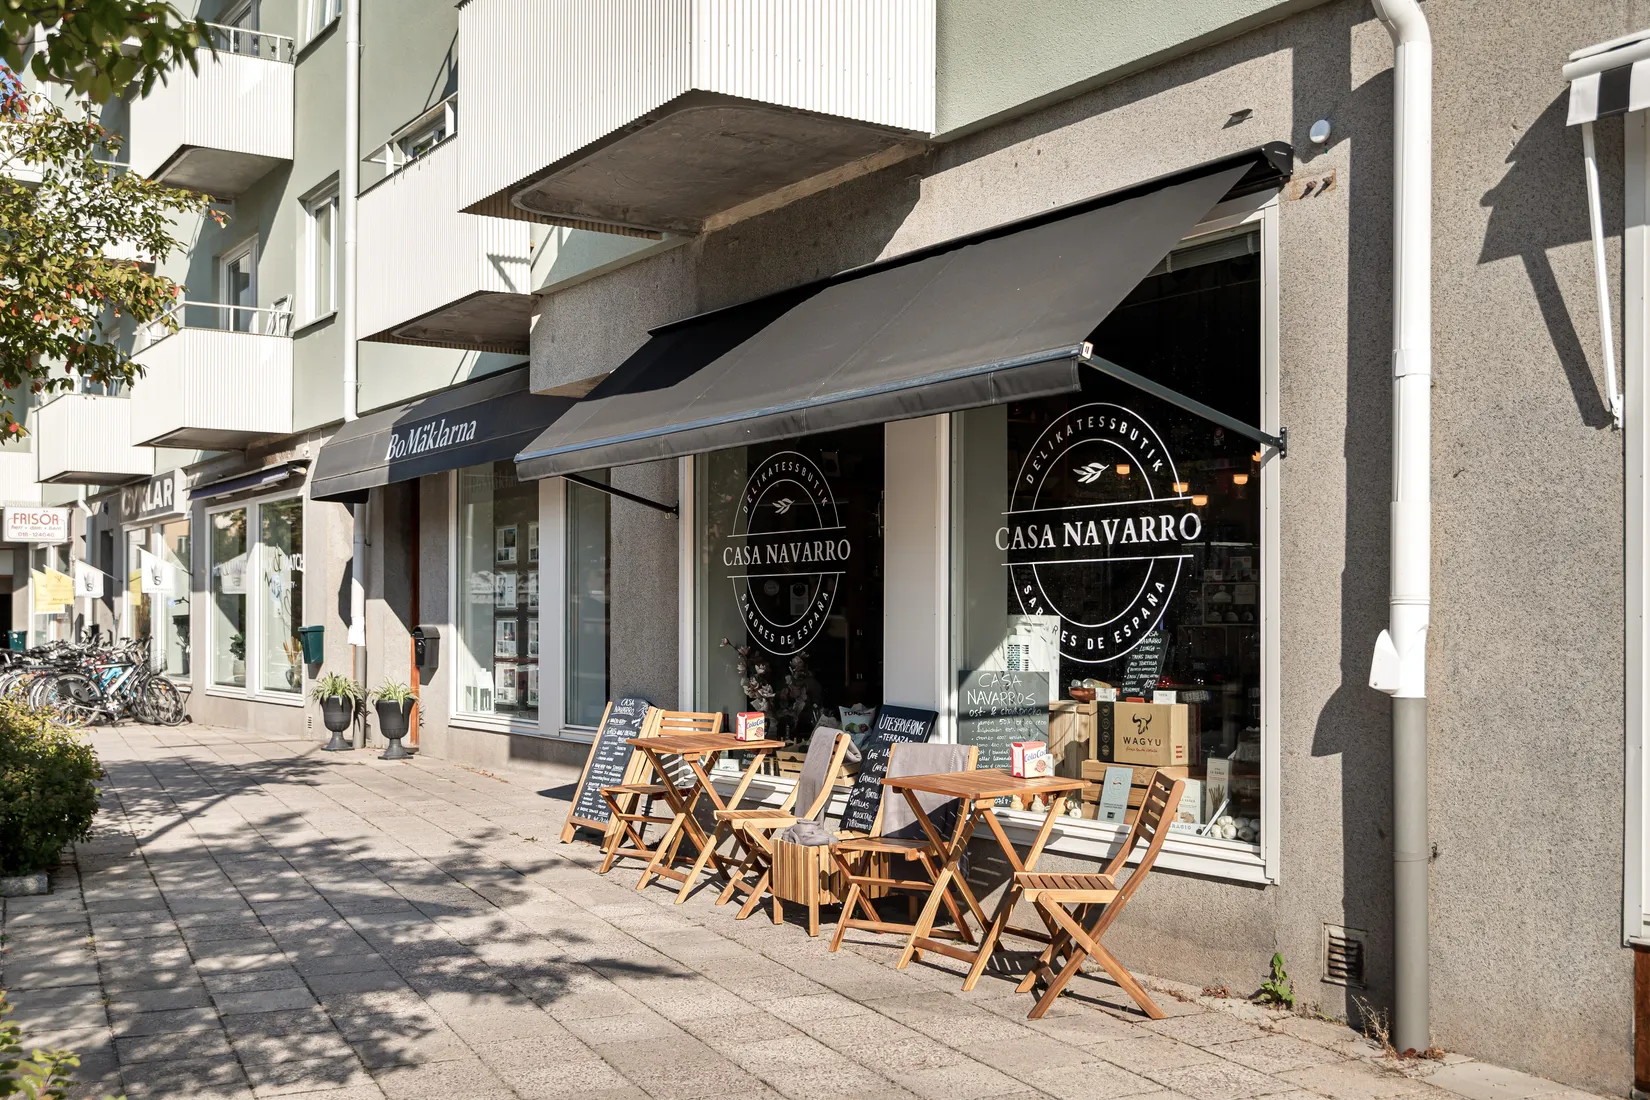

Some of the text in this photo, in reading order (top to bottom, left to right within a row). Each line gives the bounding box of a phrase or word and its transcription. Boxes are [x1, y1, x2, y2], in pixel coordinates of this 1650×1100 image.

[384, 418, 477, 461] BoMäklarna
[1026, 415, 1163, 484] DELIKATESSBUTIK
[121, 478, 173, 516] CYKLAR
[742, 461, 828, 514] DELIKATESSBUTIK
[13, 510, 59, 525] FRISÖR
[995, 512, 1202, 551] CASA NAVARRO
[723, 539, 851, 567] CASA NAVARRO
[741, 591, 829, 645] SABORES DE ESPAÑA
[1024, 581, 1165, 650] SABRES DE ESPAÑA
[978, 672, 1022, 688] CASA
[967, 689, 1036, 706] NAVARROS
[990, 706, 997, 716] &
[878, 713, 927, 736] UTESERVERING
[1123, 736, 1162, 747] WAGYU
